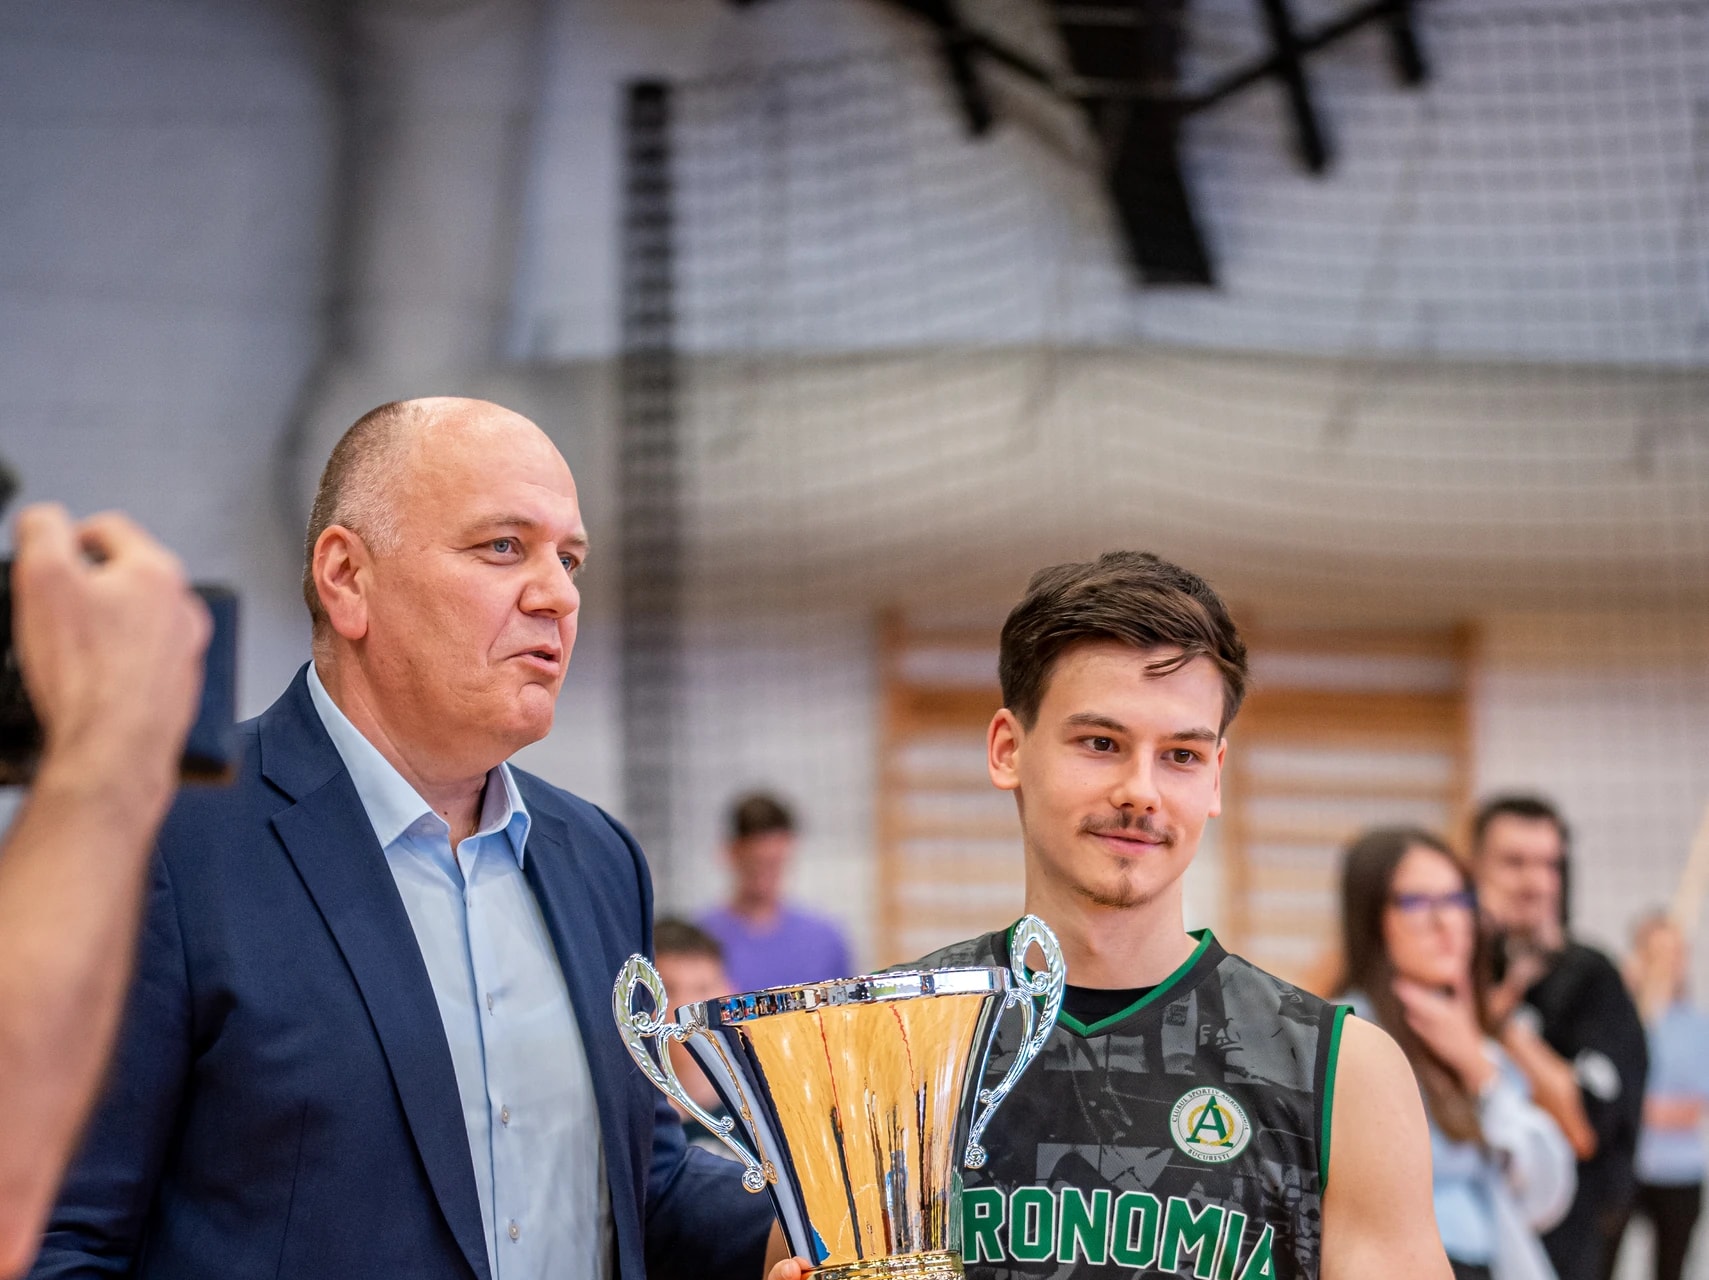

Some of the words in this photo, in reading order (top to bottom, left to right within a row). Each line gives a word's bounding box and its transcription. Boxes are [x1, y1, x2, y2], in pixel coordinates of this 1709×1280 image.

[1172, 1098, 1188, 1123] CLUBUL
[1188, 1089, 1219, 1098] SPORTIV
[1186, 1096, 1233, 1148] A
